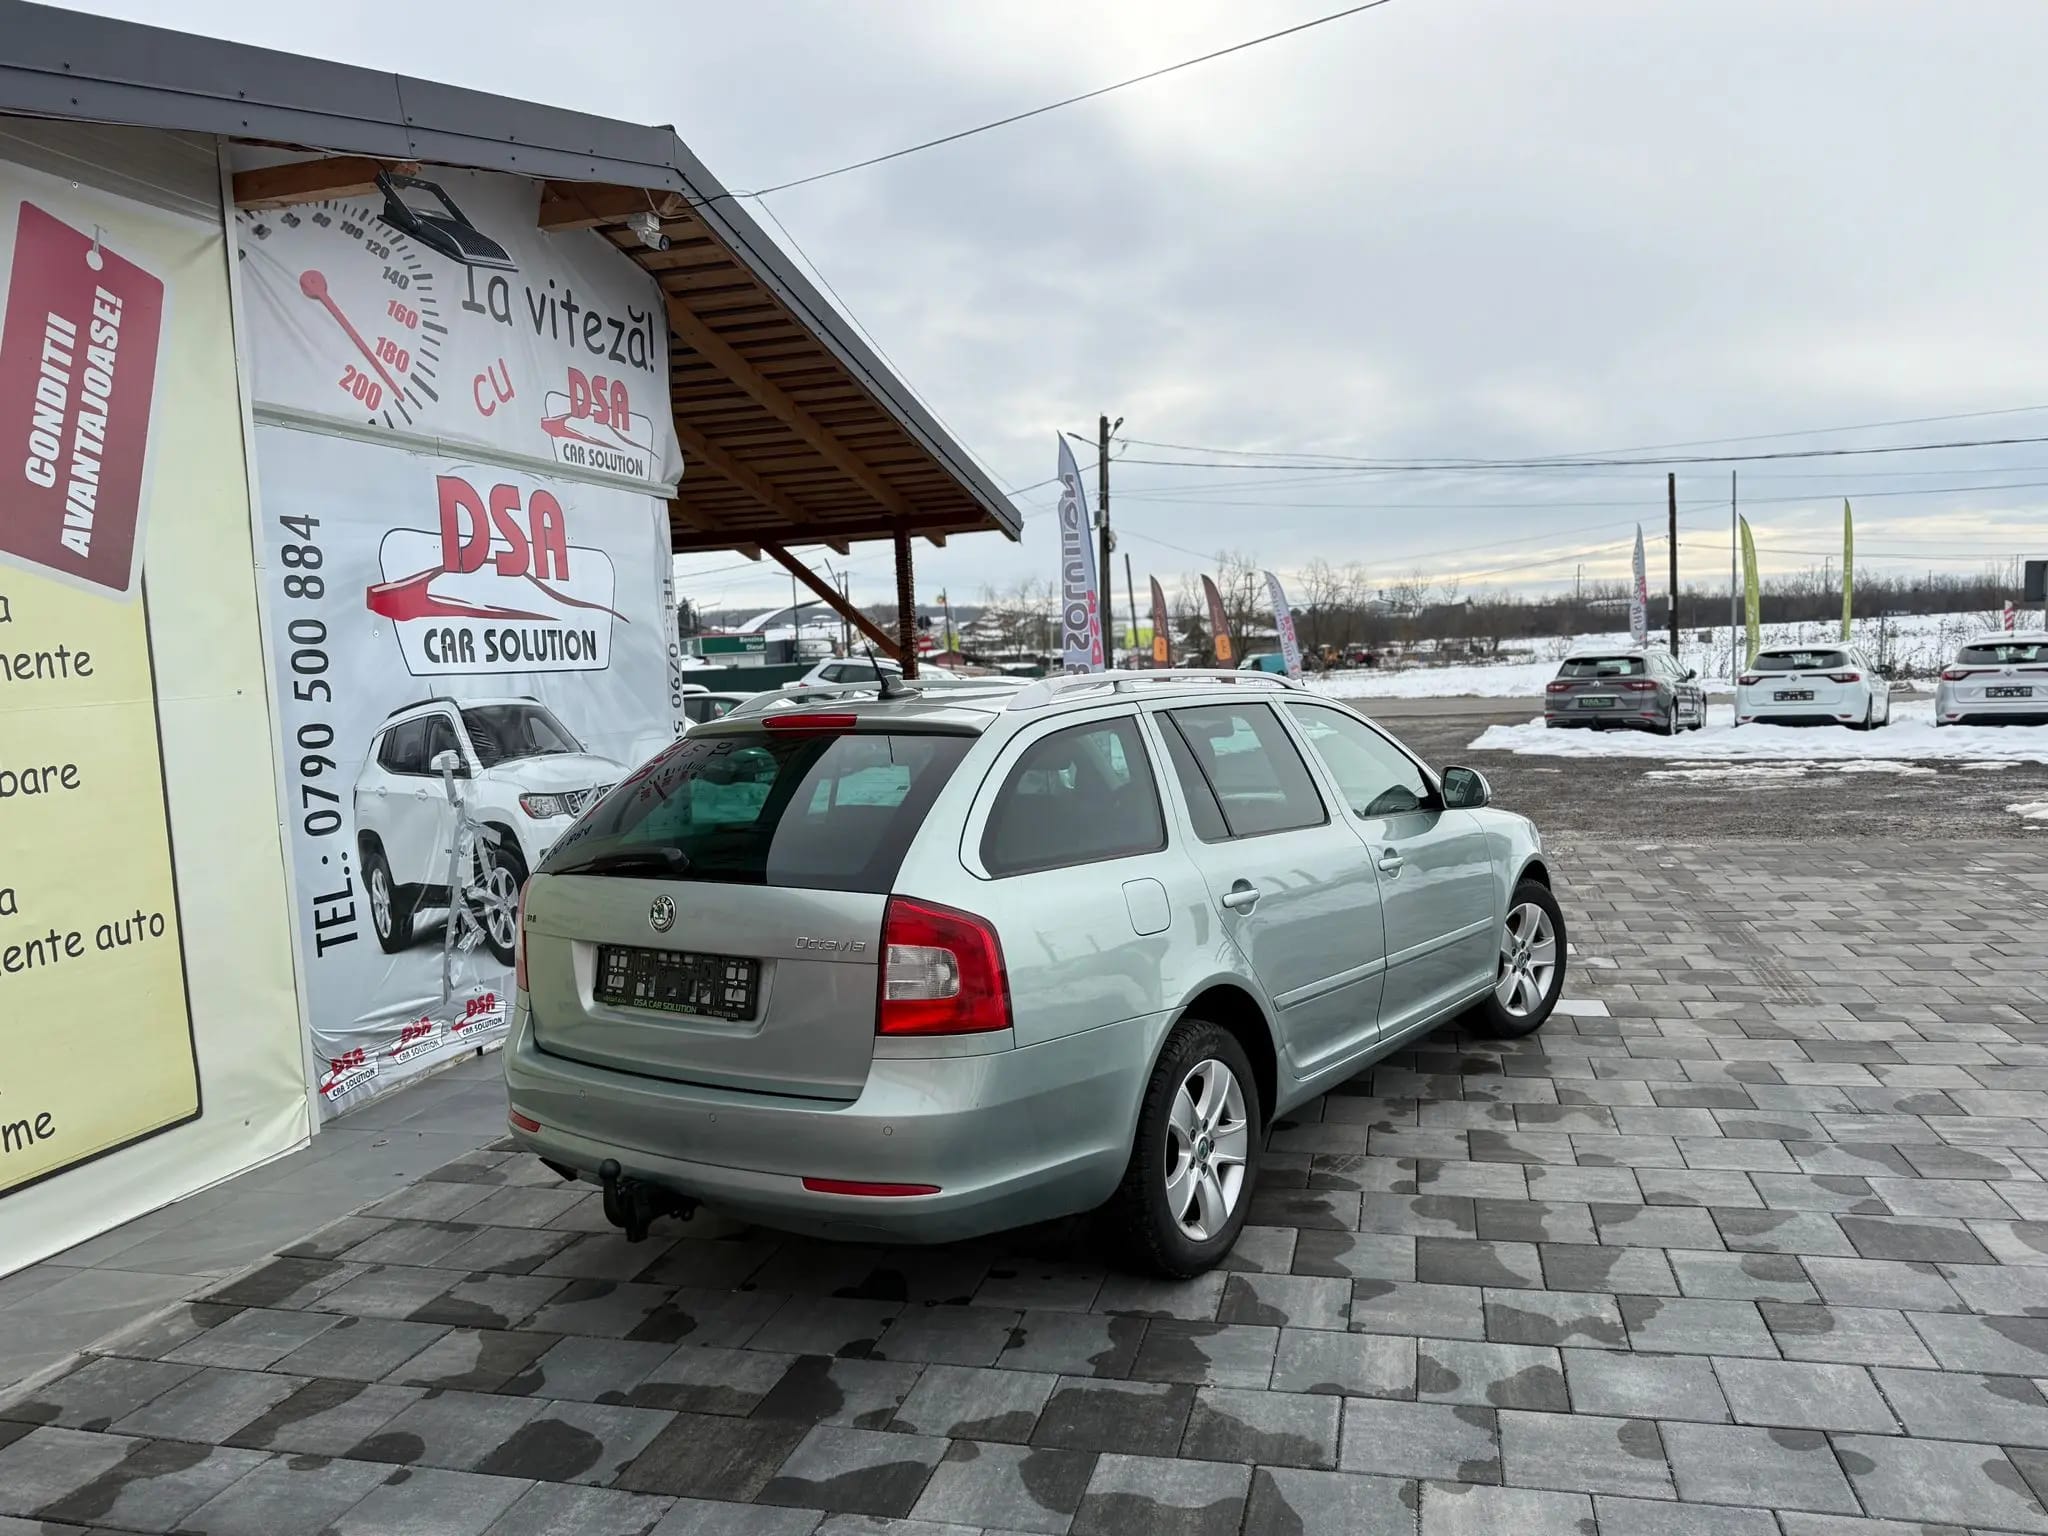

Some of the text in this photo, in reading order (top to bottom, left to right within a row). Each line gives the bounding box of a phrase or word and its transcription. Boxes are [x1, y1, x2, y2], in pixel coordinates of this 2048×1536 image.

[312, 212, 331, 228] 80
[340, 220, 364, 239] 100
[365, 239, 390, 260] 120
[382, 266, 410, 290] 140
[388, 299, 418, 330] 160
[525, 278, 655, 373] viteză!
[375, 336, 410, 374] 180
[25, 311, 76, 489] CONDITII
[338, 364, 383, 411] 200
[567, 366, 630, 432] DSA
[61, 285, 123, 559] AVANTAJOASE!
[563, 442, 643, 477] CAR SOLUTION
[436, 474, 569, 582] DSA
[279, 513, 326, 601] 884
[287, 618, 333, 704] 500
[423, 628, 597, 664] CAR SOLUTION
[669, 642, 682, 709] 0790
[296, 722, 343, 838] 0790
[95, 909, 165, 951] auto
[795, 936, 866, 952] Octavia
[467, 992, 496, 1017] DSA
[633, 998, 648, 1007] DSA
[648, 1000, 662, 1009] CAR
[662, 1002, 697, 1014] SOLUTION
[462, 1017, 503, 1036] CAR SOLUTION
[399, 1039, 440, 1062] CAR SOLUTION
[332, 1067, 376, 1097] CAR SOLUTION
[2, 1111, 56, 1154] me
